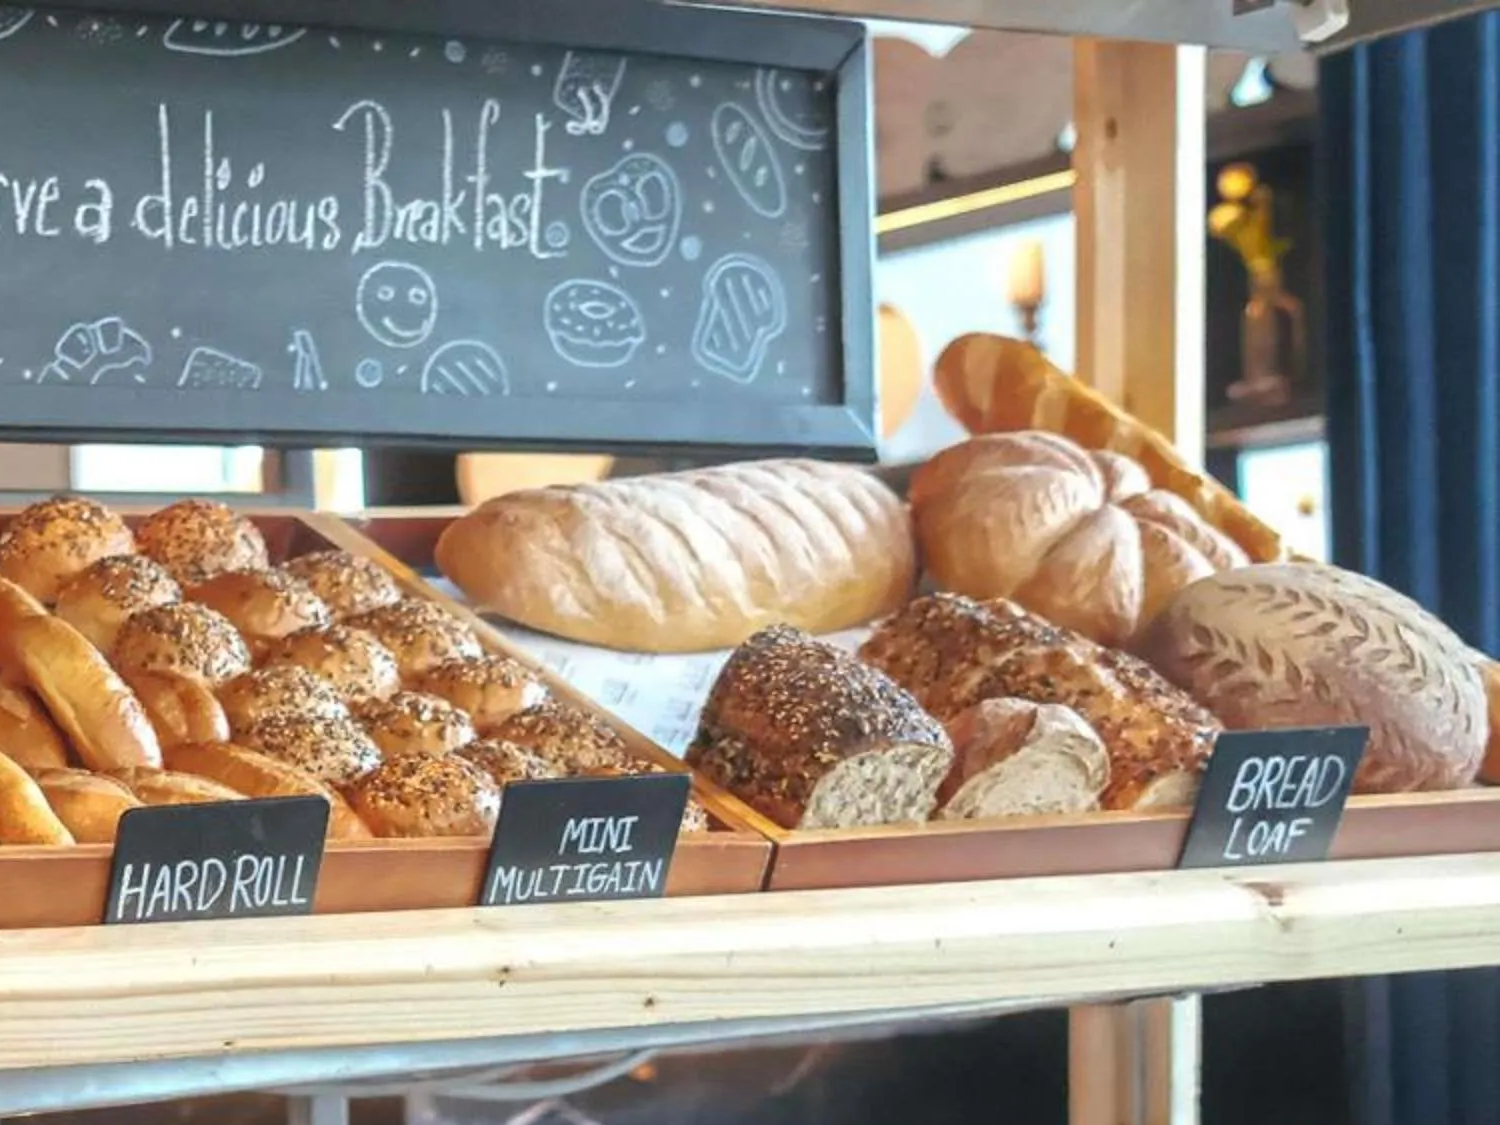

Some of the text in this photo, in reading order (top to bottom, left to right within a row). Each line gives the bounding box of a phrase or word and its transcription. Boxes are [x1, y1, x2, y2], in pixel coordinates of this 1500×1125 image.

[74, 177, 114, 245] a
[131, 102, 341, 251] delicious
[1226, 754, 1346, 813] BREAD
[558, 815, 639, 856] MINI
[1223, 816, 1314, 860] LOAF
[116, 853, 308, 920] HARD ROLL
[488, 858, 664, 905] MULTIGAIN
